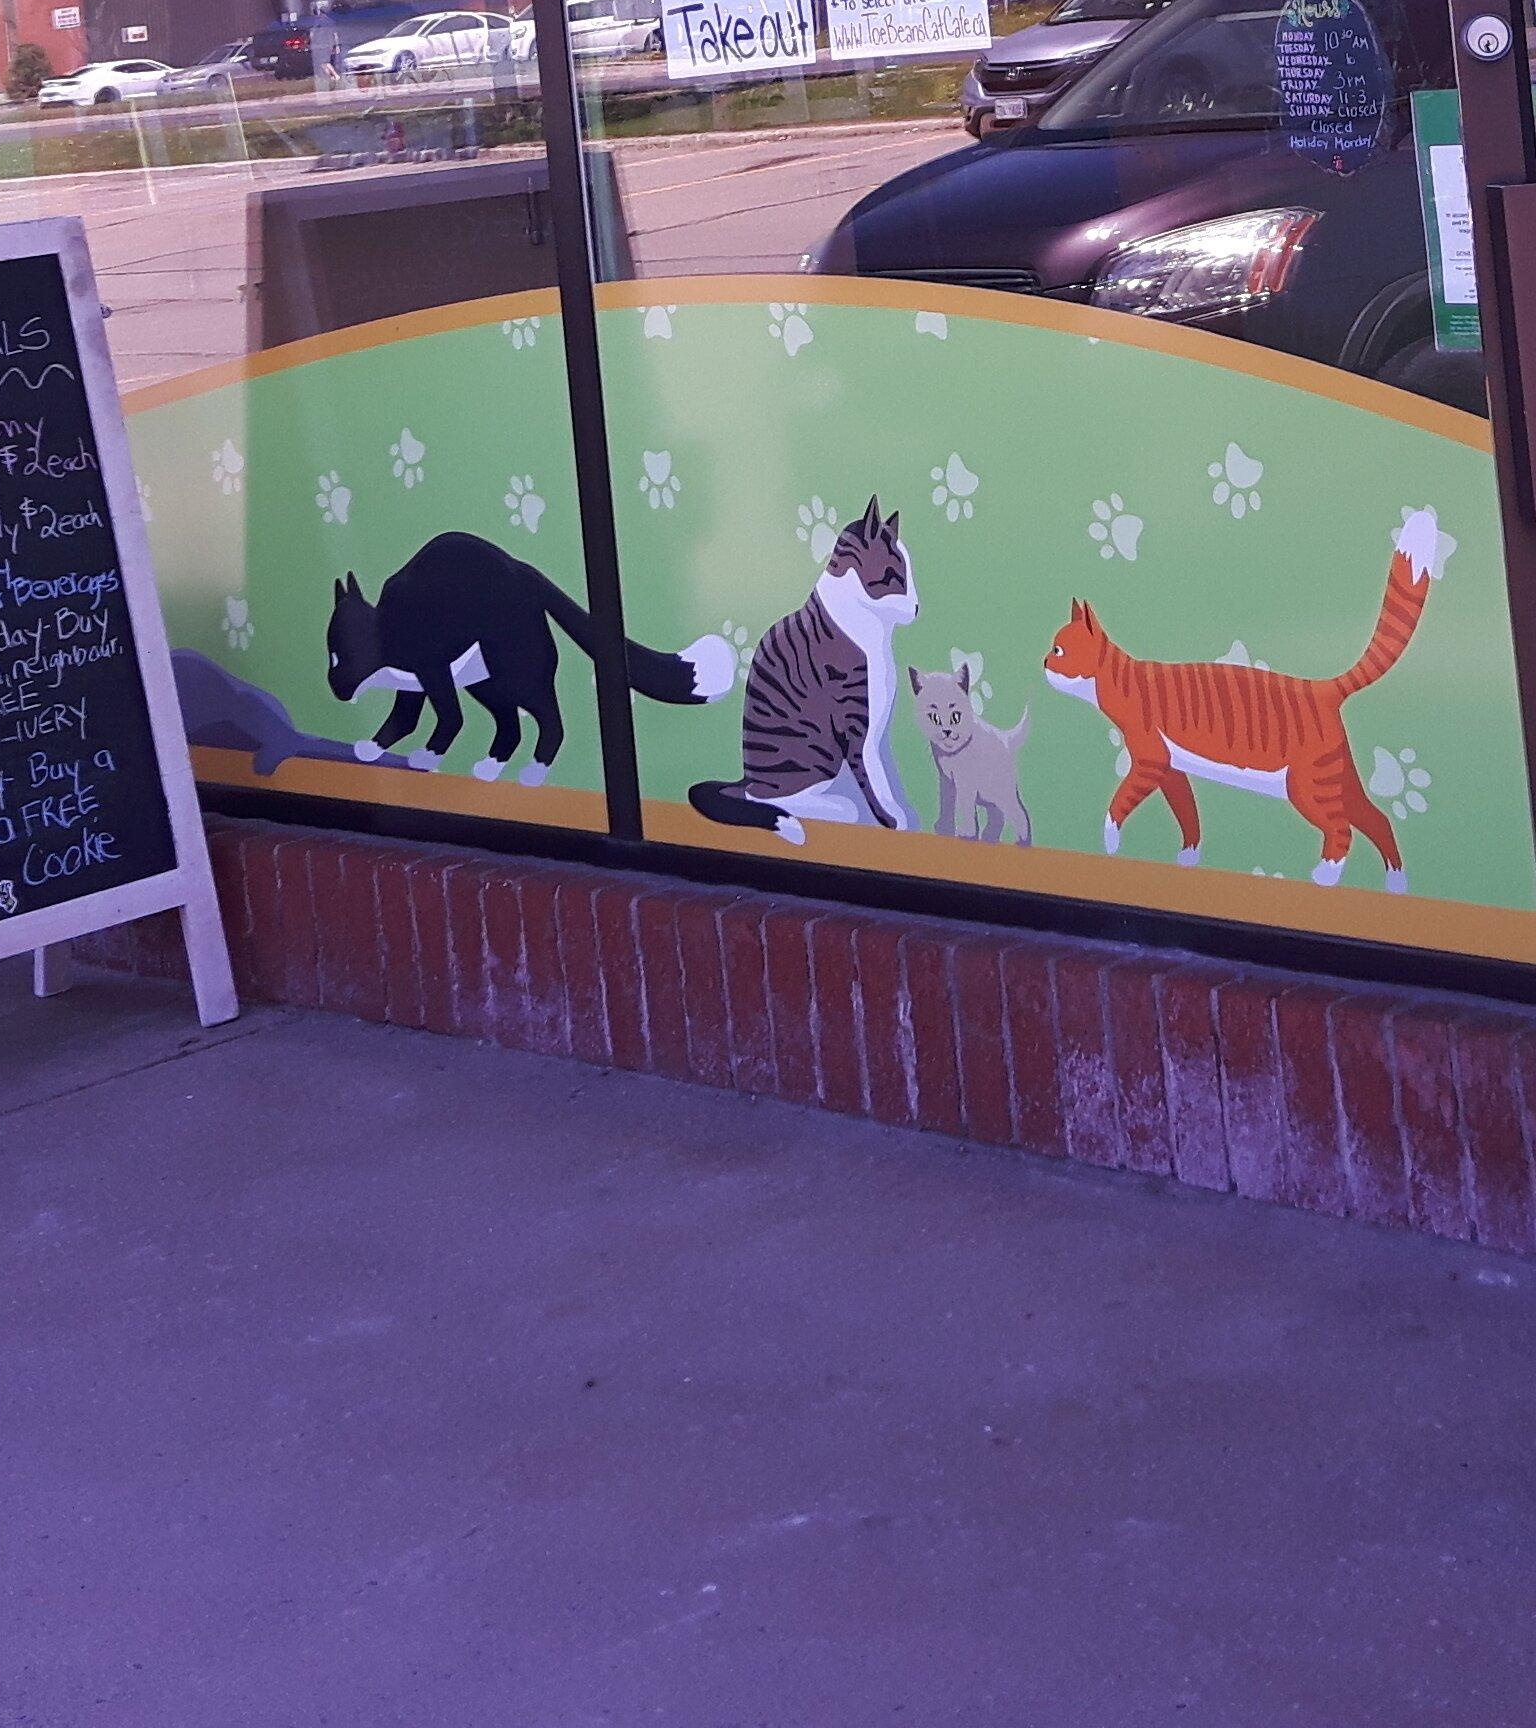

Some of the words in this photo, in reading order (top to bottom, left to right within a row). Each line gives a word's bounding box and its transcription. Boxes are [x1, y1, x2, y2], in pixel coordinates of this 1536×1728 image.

[1281, 31, 1314, 41] MONDAY
[1278, 67, 1326, 79] THURSDAY
[1284, 91, 1333, 104] SATURDAY
[1310, 120, 1353, 134] Closed
[1290, 135, 1329, 150] Holiday
[29, 751, 81, 797] Buy
[20, 783, 101, 839] FREE
